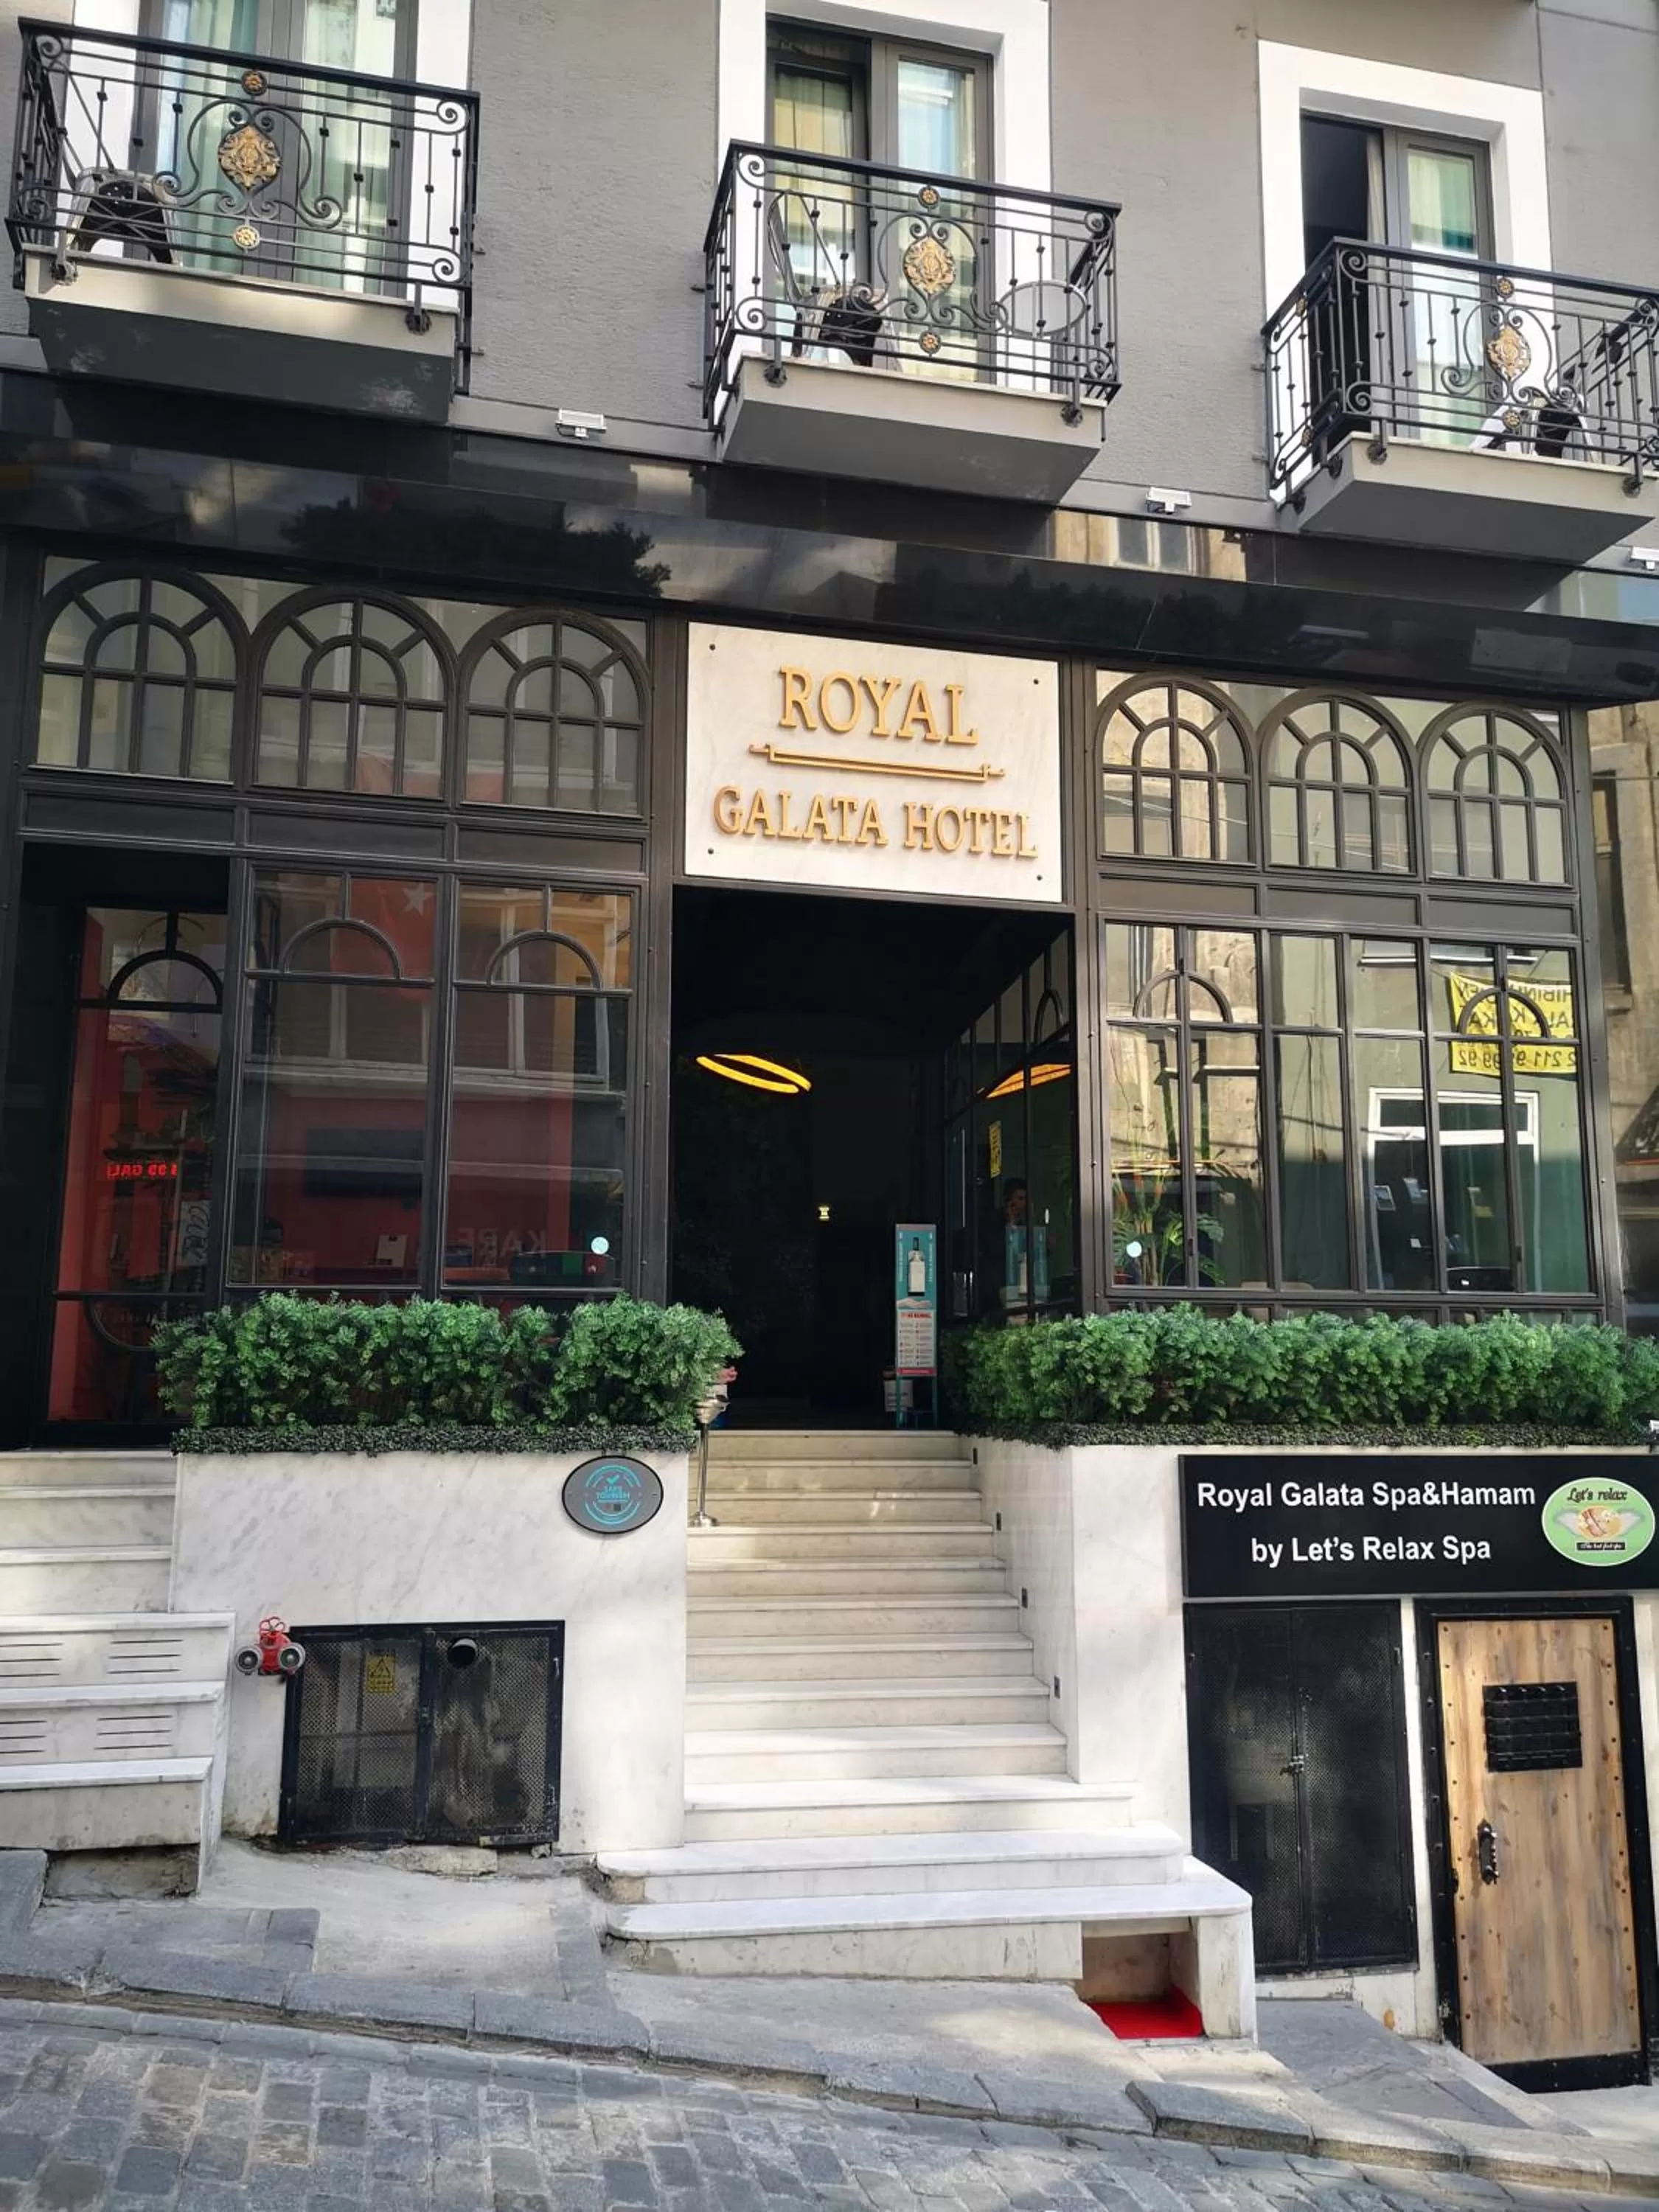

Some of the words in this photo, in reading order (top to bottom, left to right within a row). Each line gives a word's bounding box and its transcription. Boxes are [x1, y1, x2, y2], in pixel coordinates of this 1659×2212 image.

[779, 664, 979, 745] ROYAL
[713, 785, 888, 845] GALATA
[903, 801, 1038, 859] HOTEL
[1197, 1482, 1272, 1513] Royal
[1281, 1482, 1364, 1506] Galata
[1372, 1481, 1536, 1511] Spa&Hamam
[1567, 1487, 1593, 1503] Let's
[1598, 1487, 1627, 1500] relax
[1251, 1537, 1283, 1568] by
[1292, 1537, 1354, 1562] Let's
[1363, 1536, 1434, 1560] Relax
[1443, 1535, 1491, 1565] Spa
